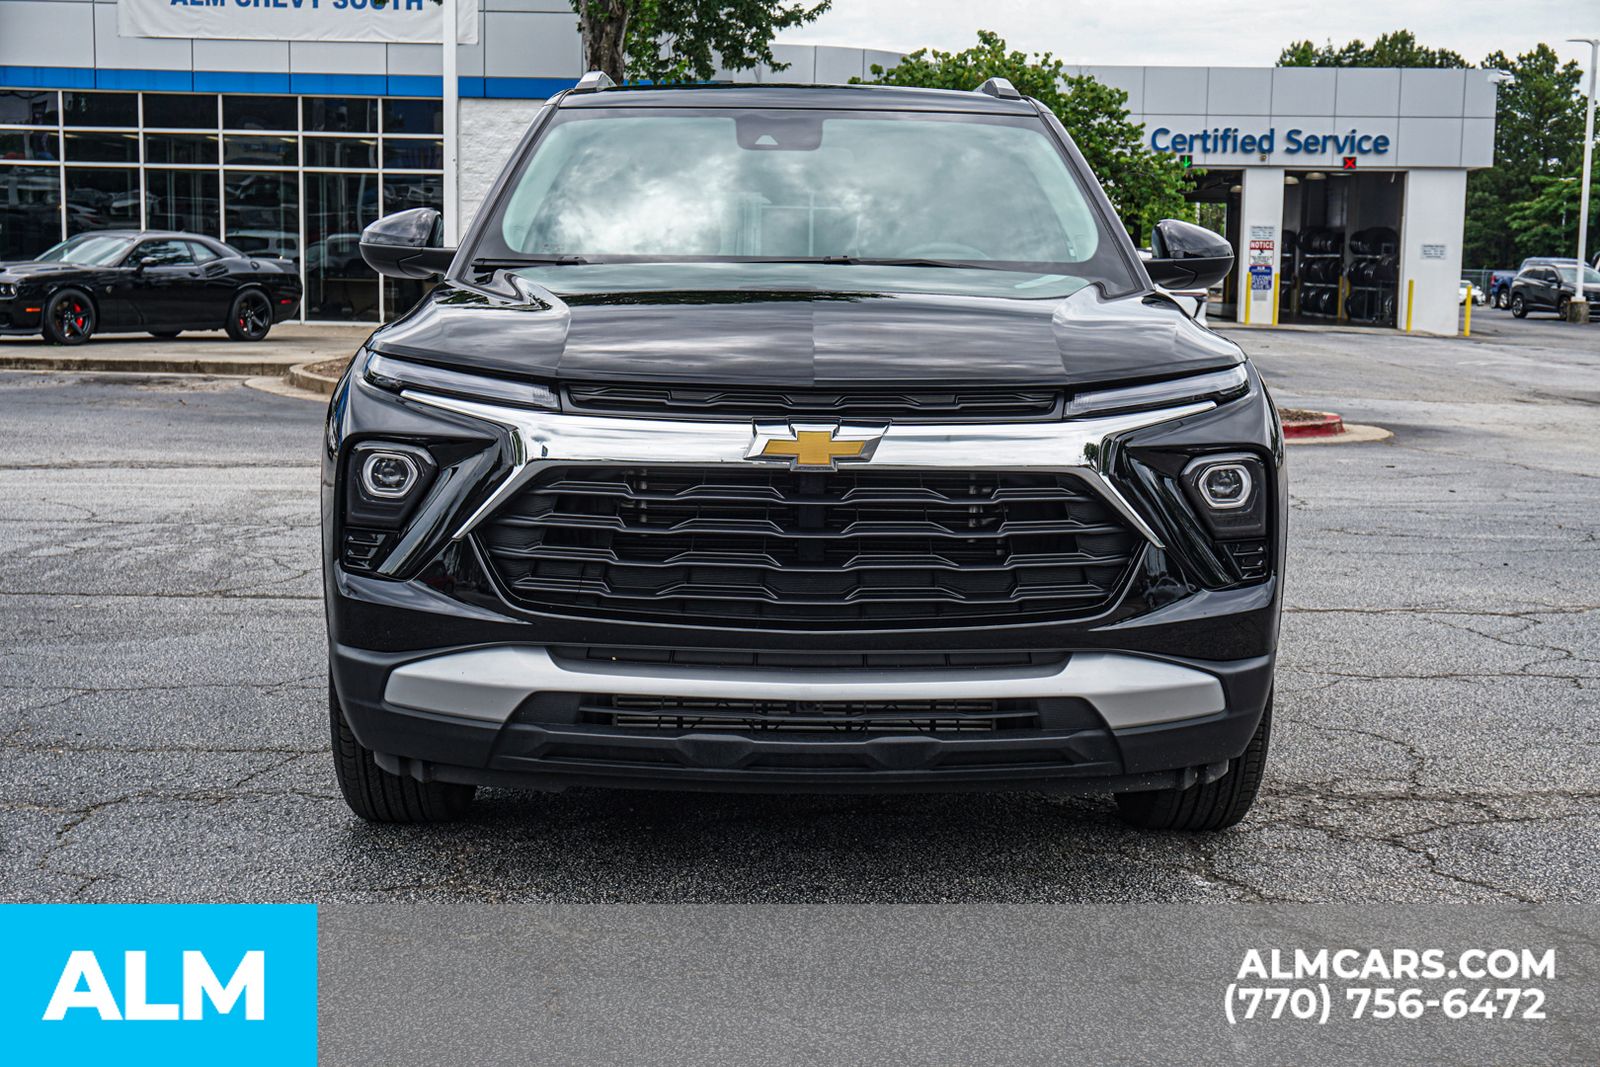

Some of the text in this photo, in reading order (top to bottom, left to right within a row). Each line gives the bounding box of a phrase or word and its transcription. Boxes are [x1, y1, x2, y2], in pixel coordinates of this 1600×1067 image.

[1151, 127, 1391, 154] Certified Service
[1250, 241, 1274, 249] NOTICE
